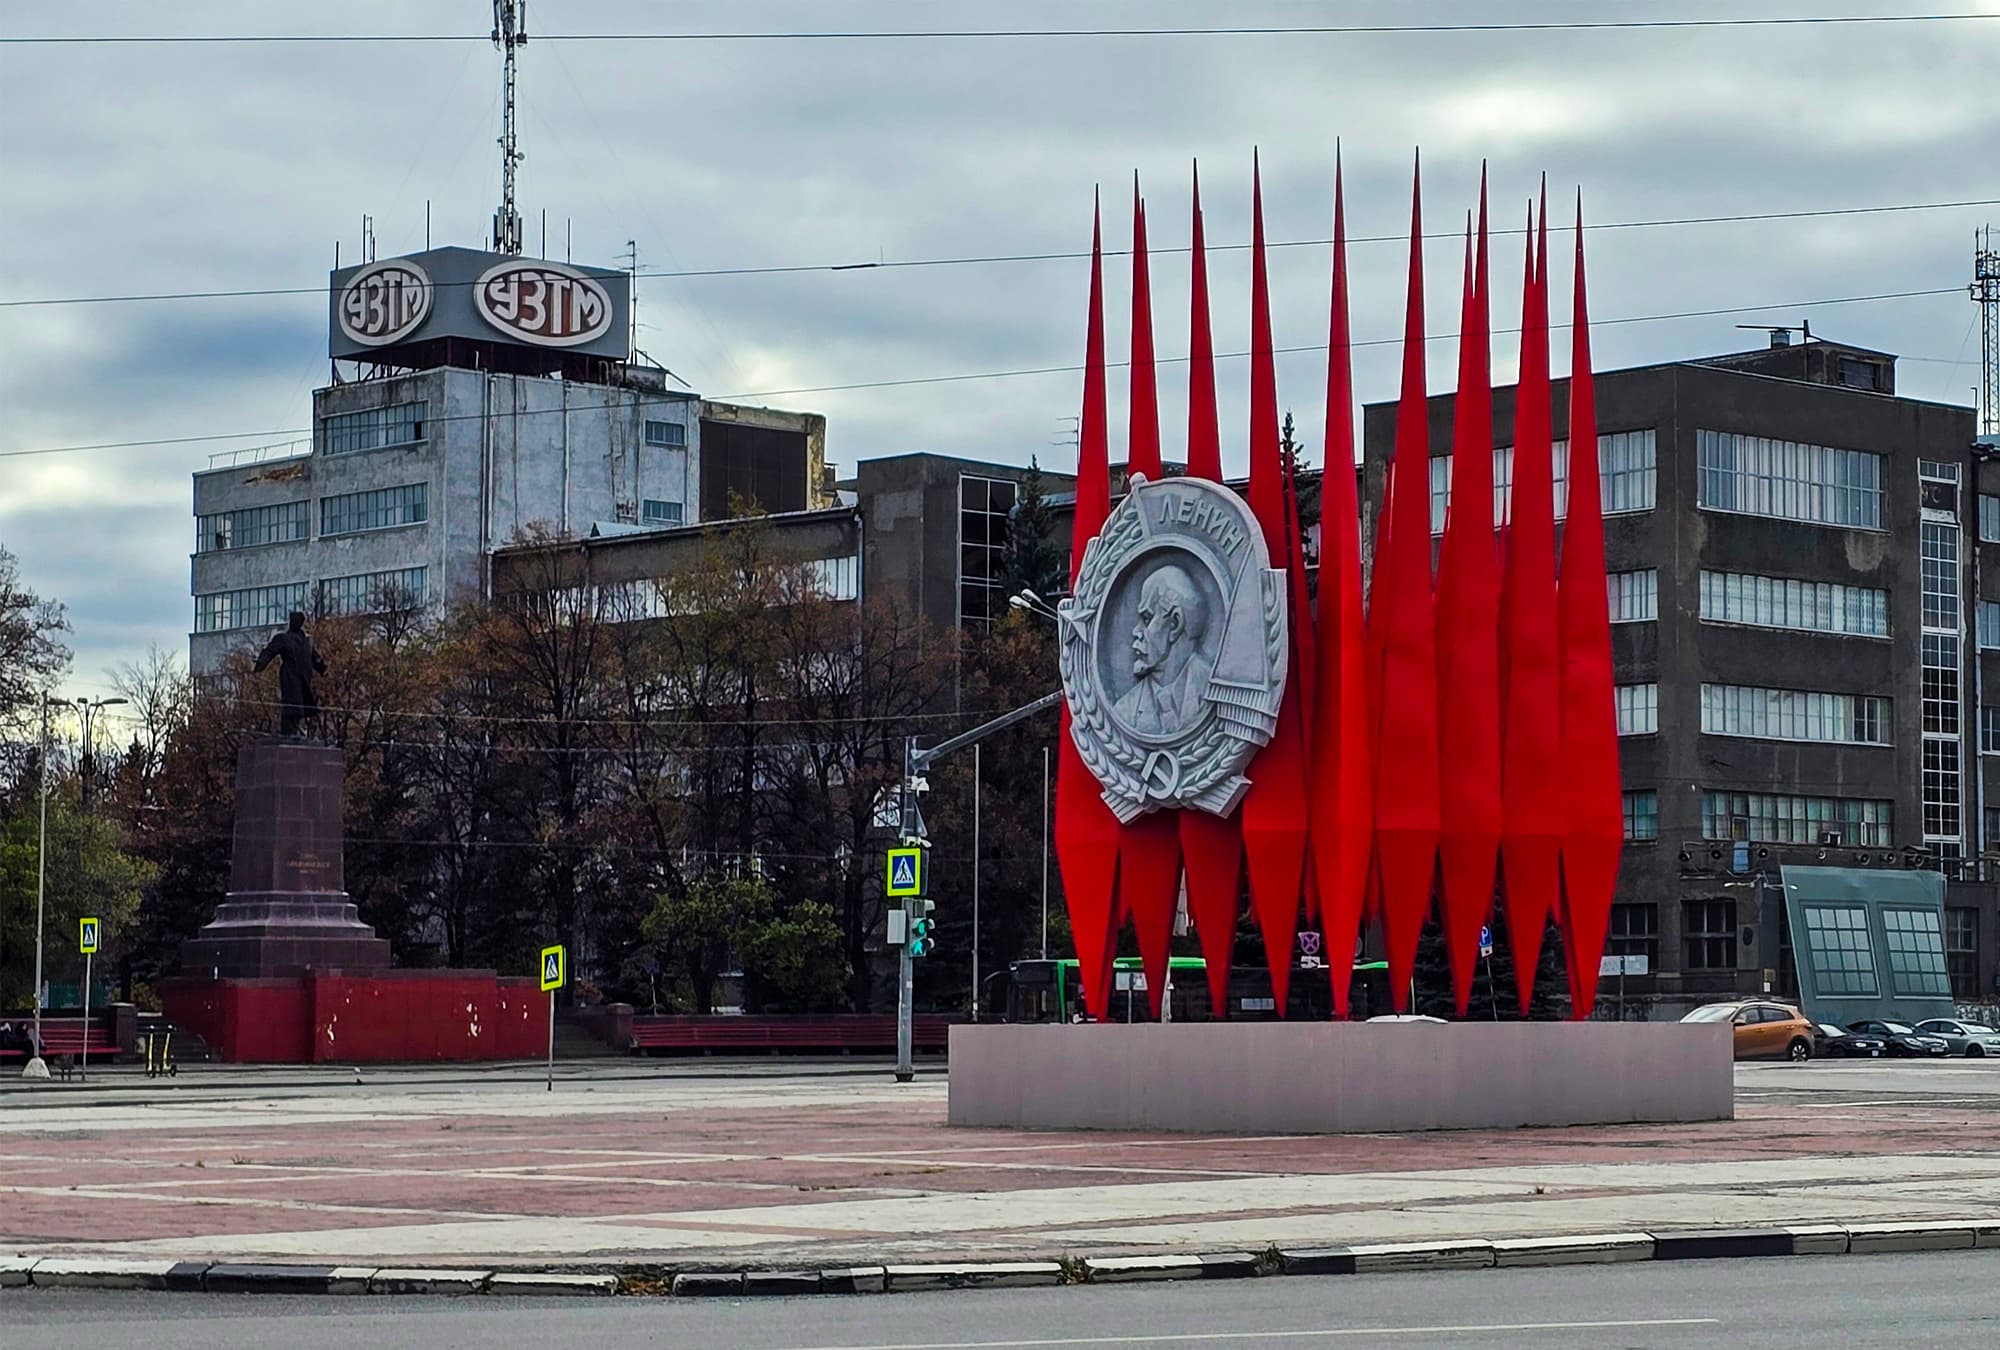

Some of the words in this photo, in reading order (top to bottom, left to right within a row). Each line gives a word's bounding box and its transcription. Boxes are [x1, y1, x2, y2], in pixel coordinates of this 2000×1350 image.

[347, 270, 425, 334] УЗТМ
[488, 270, 602, 335] УЗТМ
[1159, 494, 1245, 557] ЛЕНИН
